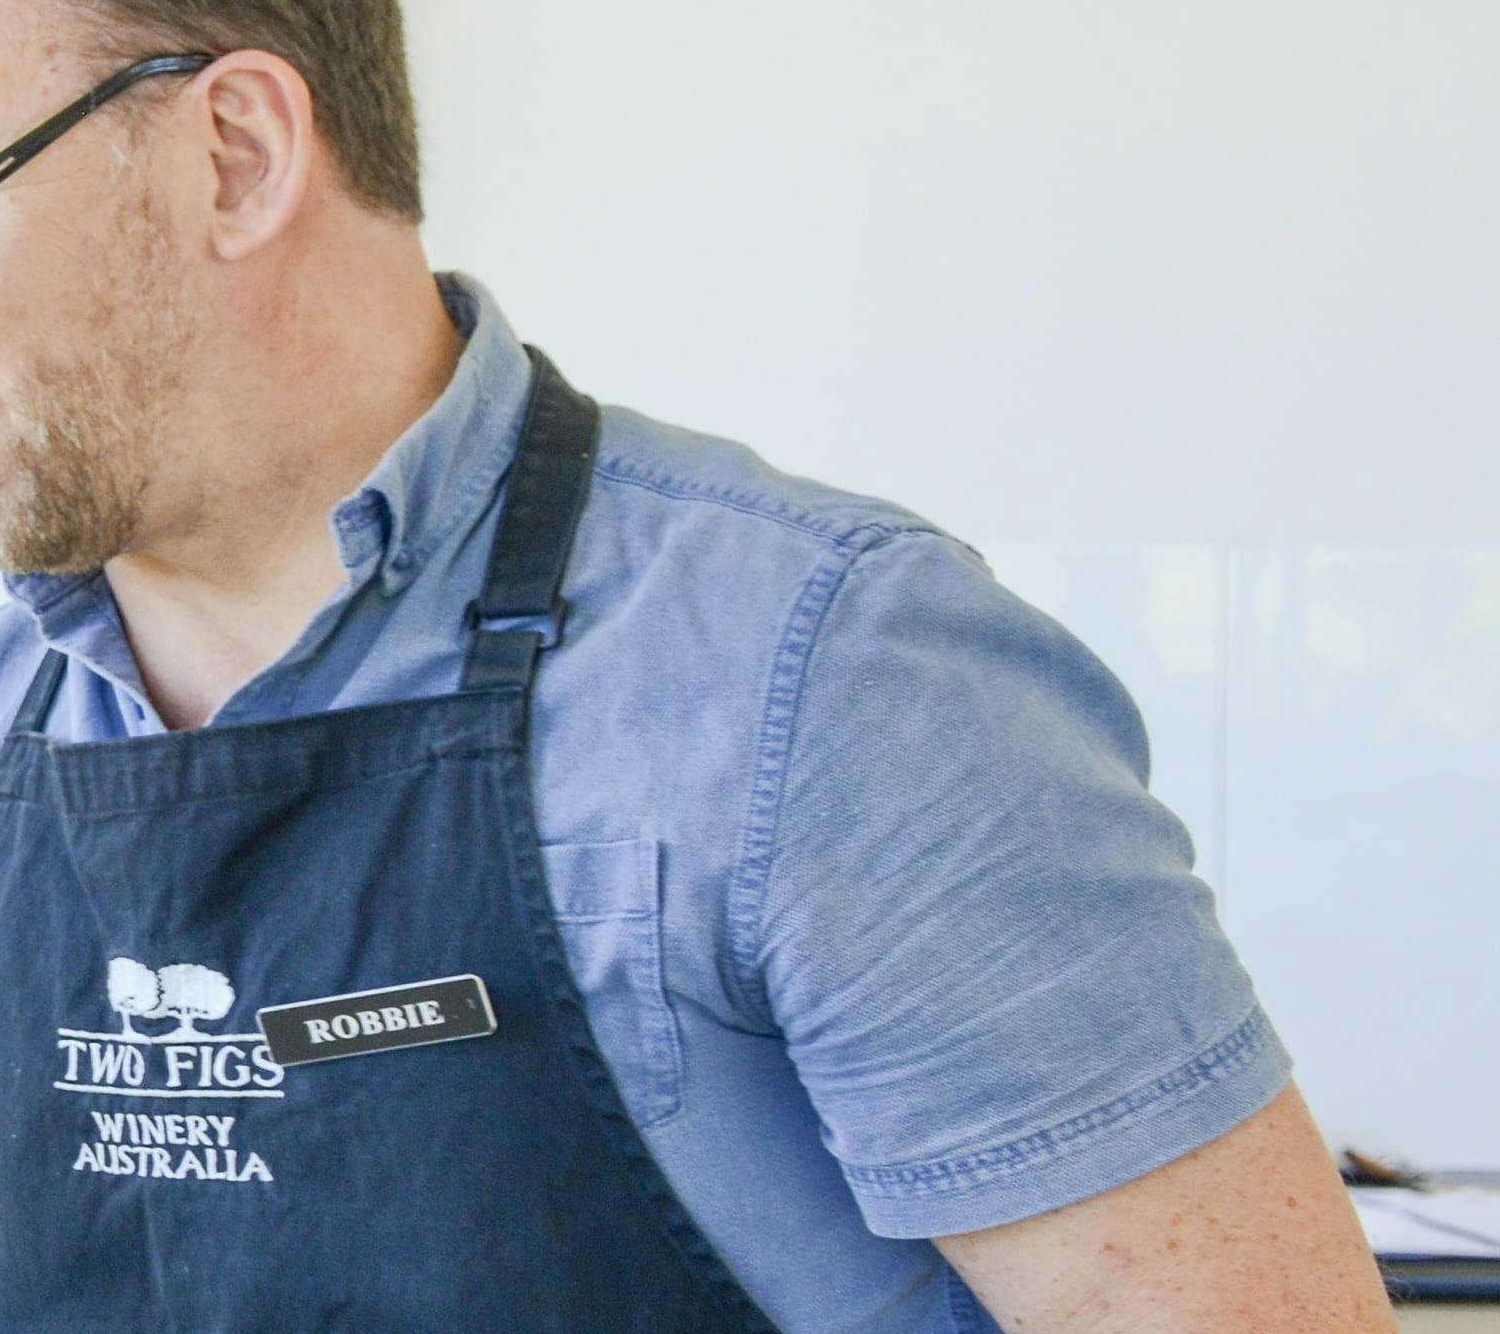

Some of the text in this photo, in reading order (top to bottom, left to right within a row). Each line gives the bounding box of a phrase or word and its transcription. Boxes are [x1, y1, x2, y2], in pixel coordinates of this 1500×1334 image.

[303, 1000, 446, 1045] ROBBIE
[57, 1040, 286, 1089] TWO FIGS
[90, 1111, 235, 1147] WINERY
[72, 1142, 275, 1182] AUSTRALIA
